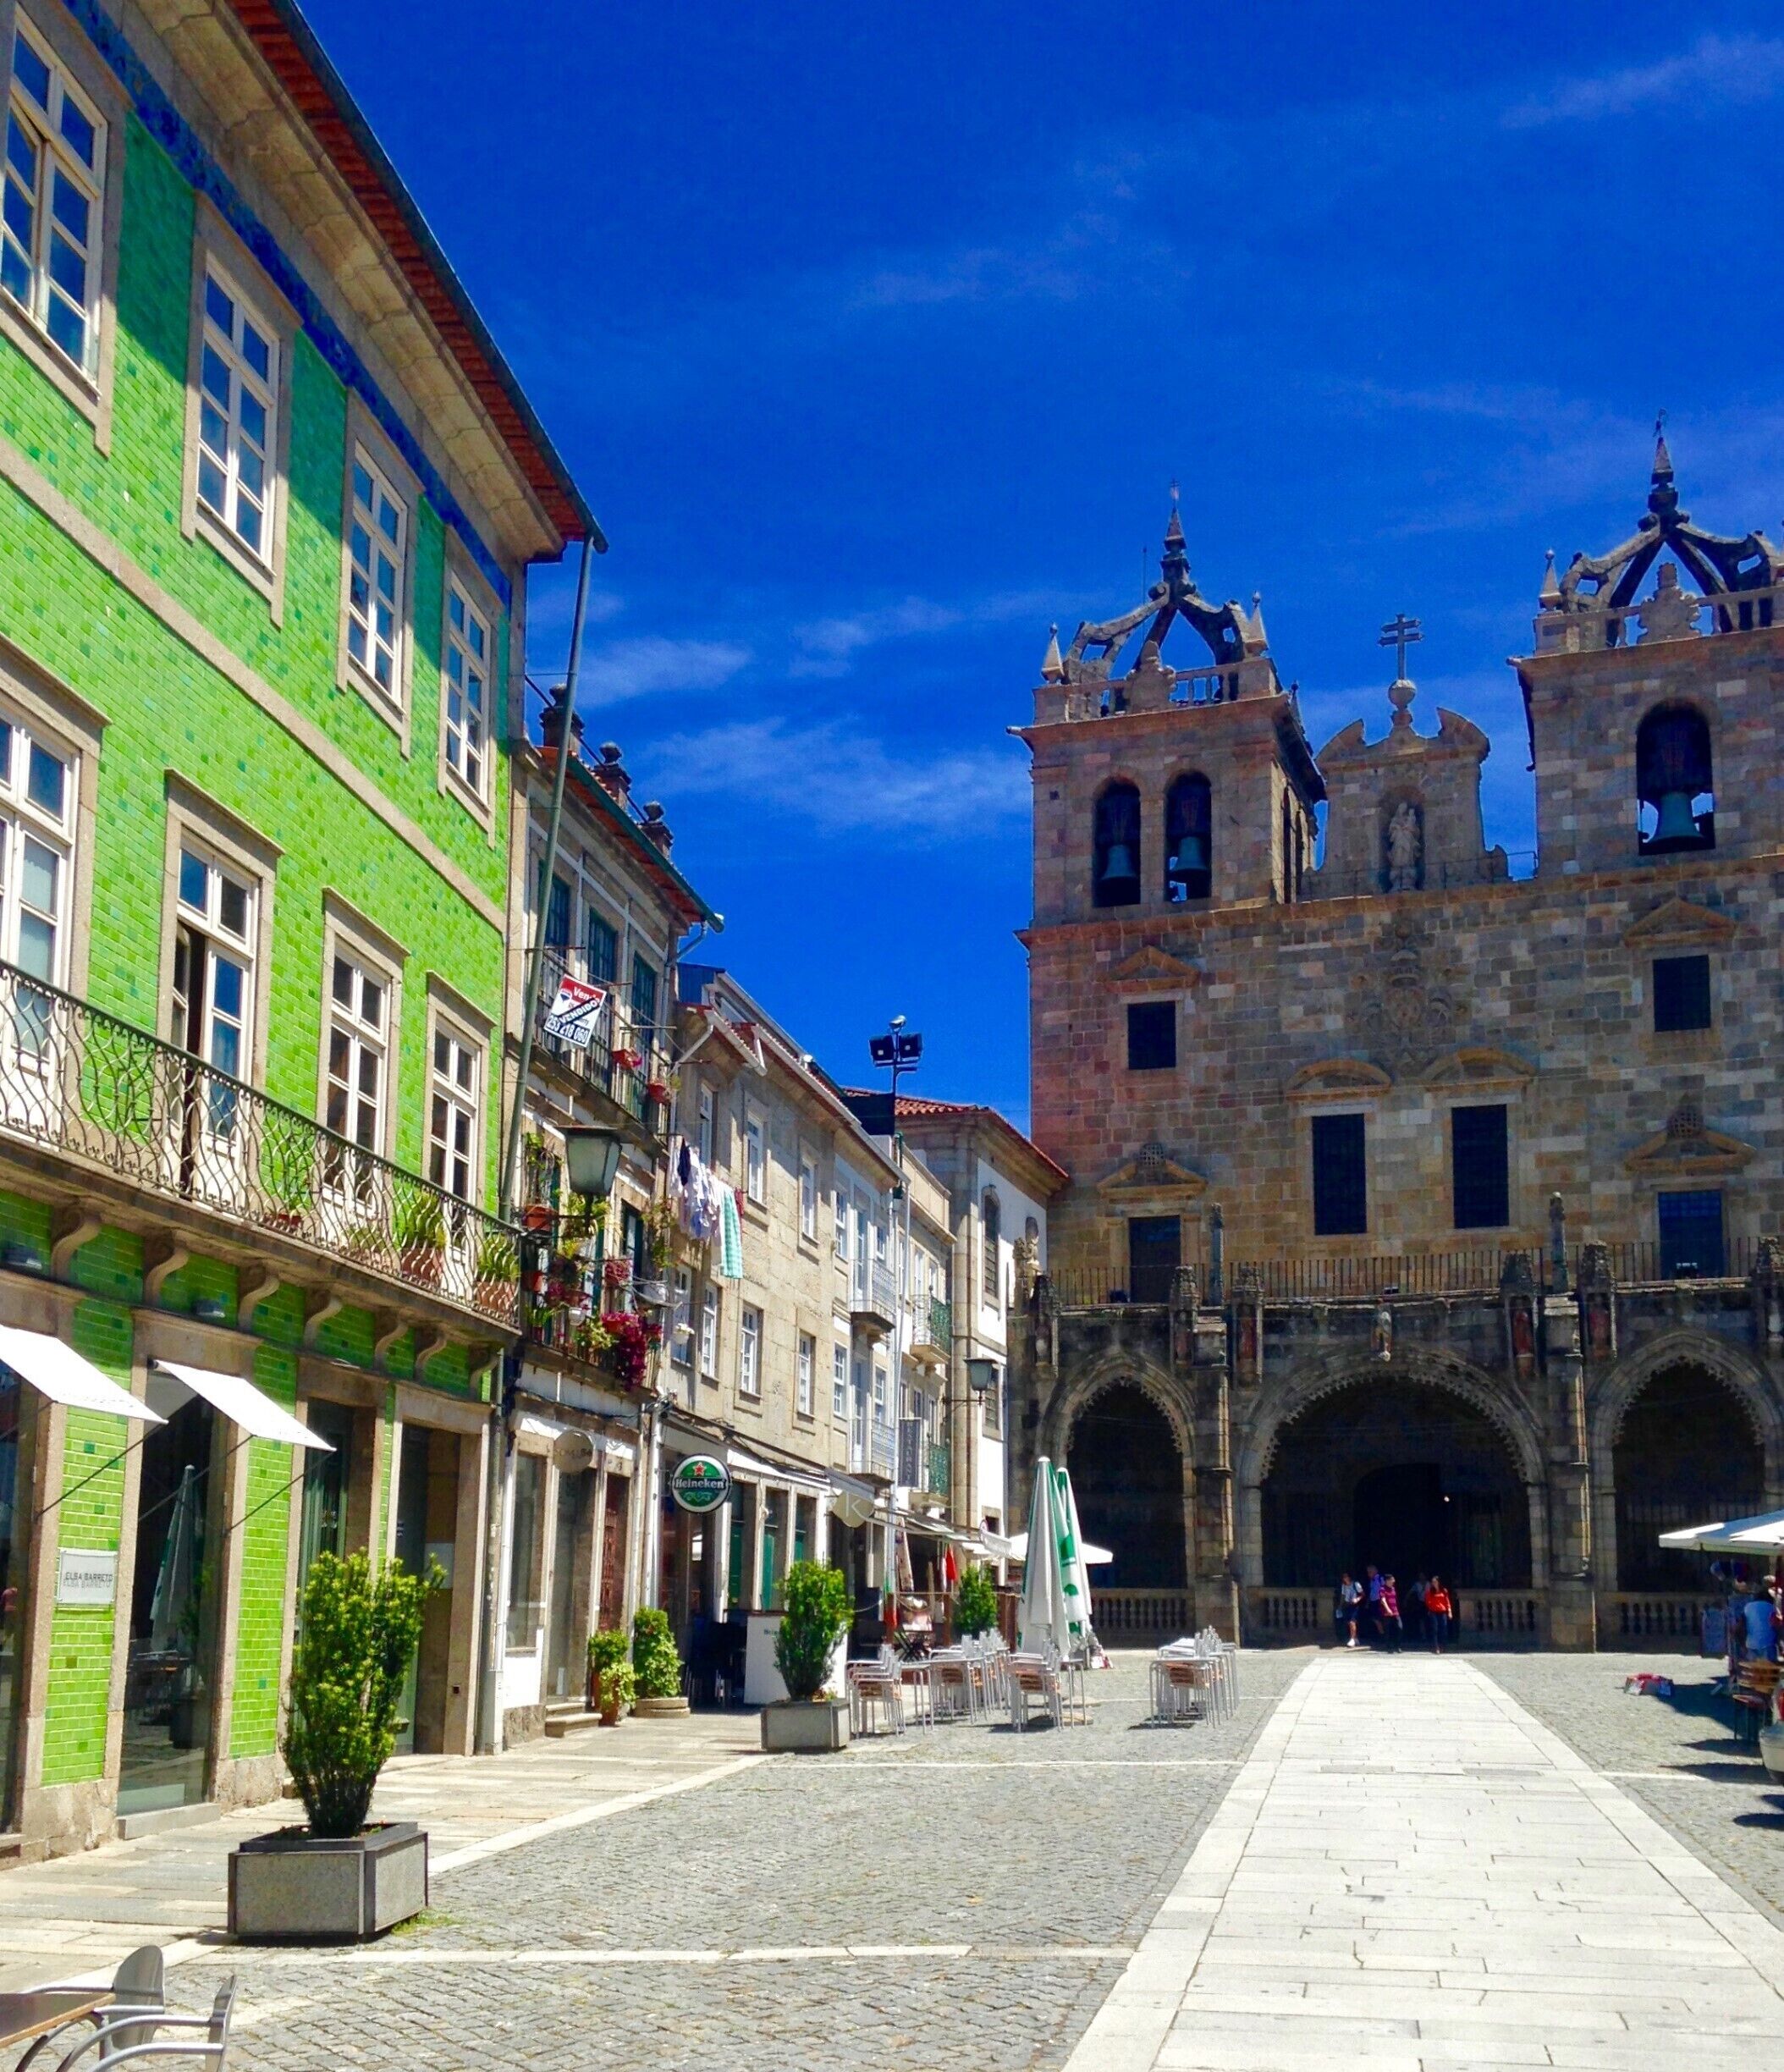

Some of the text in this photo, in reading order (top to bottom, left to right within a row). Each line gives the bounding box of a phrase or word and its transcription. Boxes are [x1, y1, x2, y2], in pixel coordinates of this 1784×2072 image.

[559, 1000, 597, 1023] VENDIDO
[675, 1478, 724, 1489] Heineken
[65, 1572, 113, 1583] ELSA BARRETO
